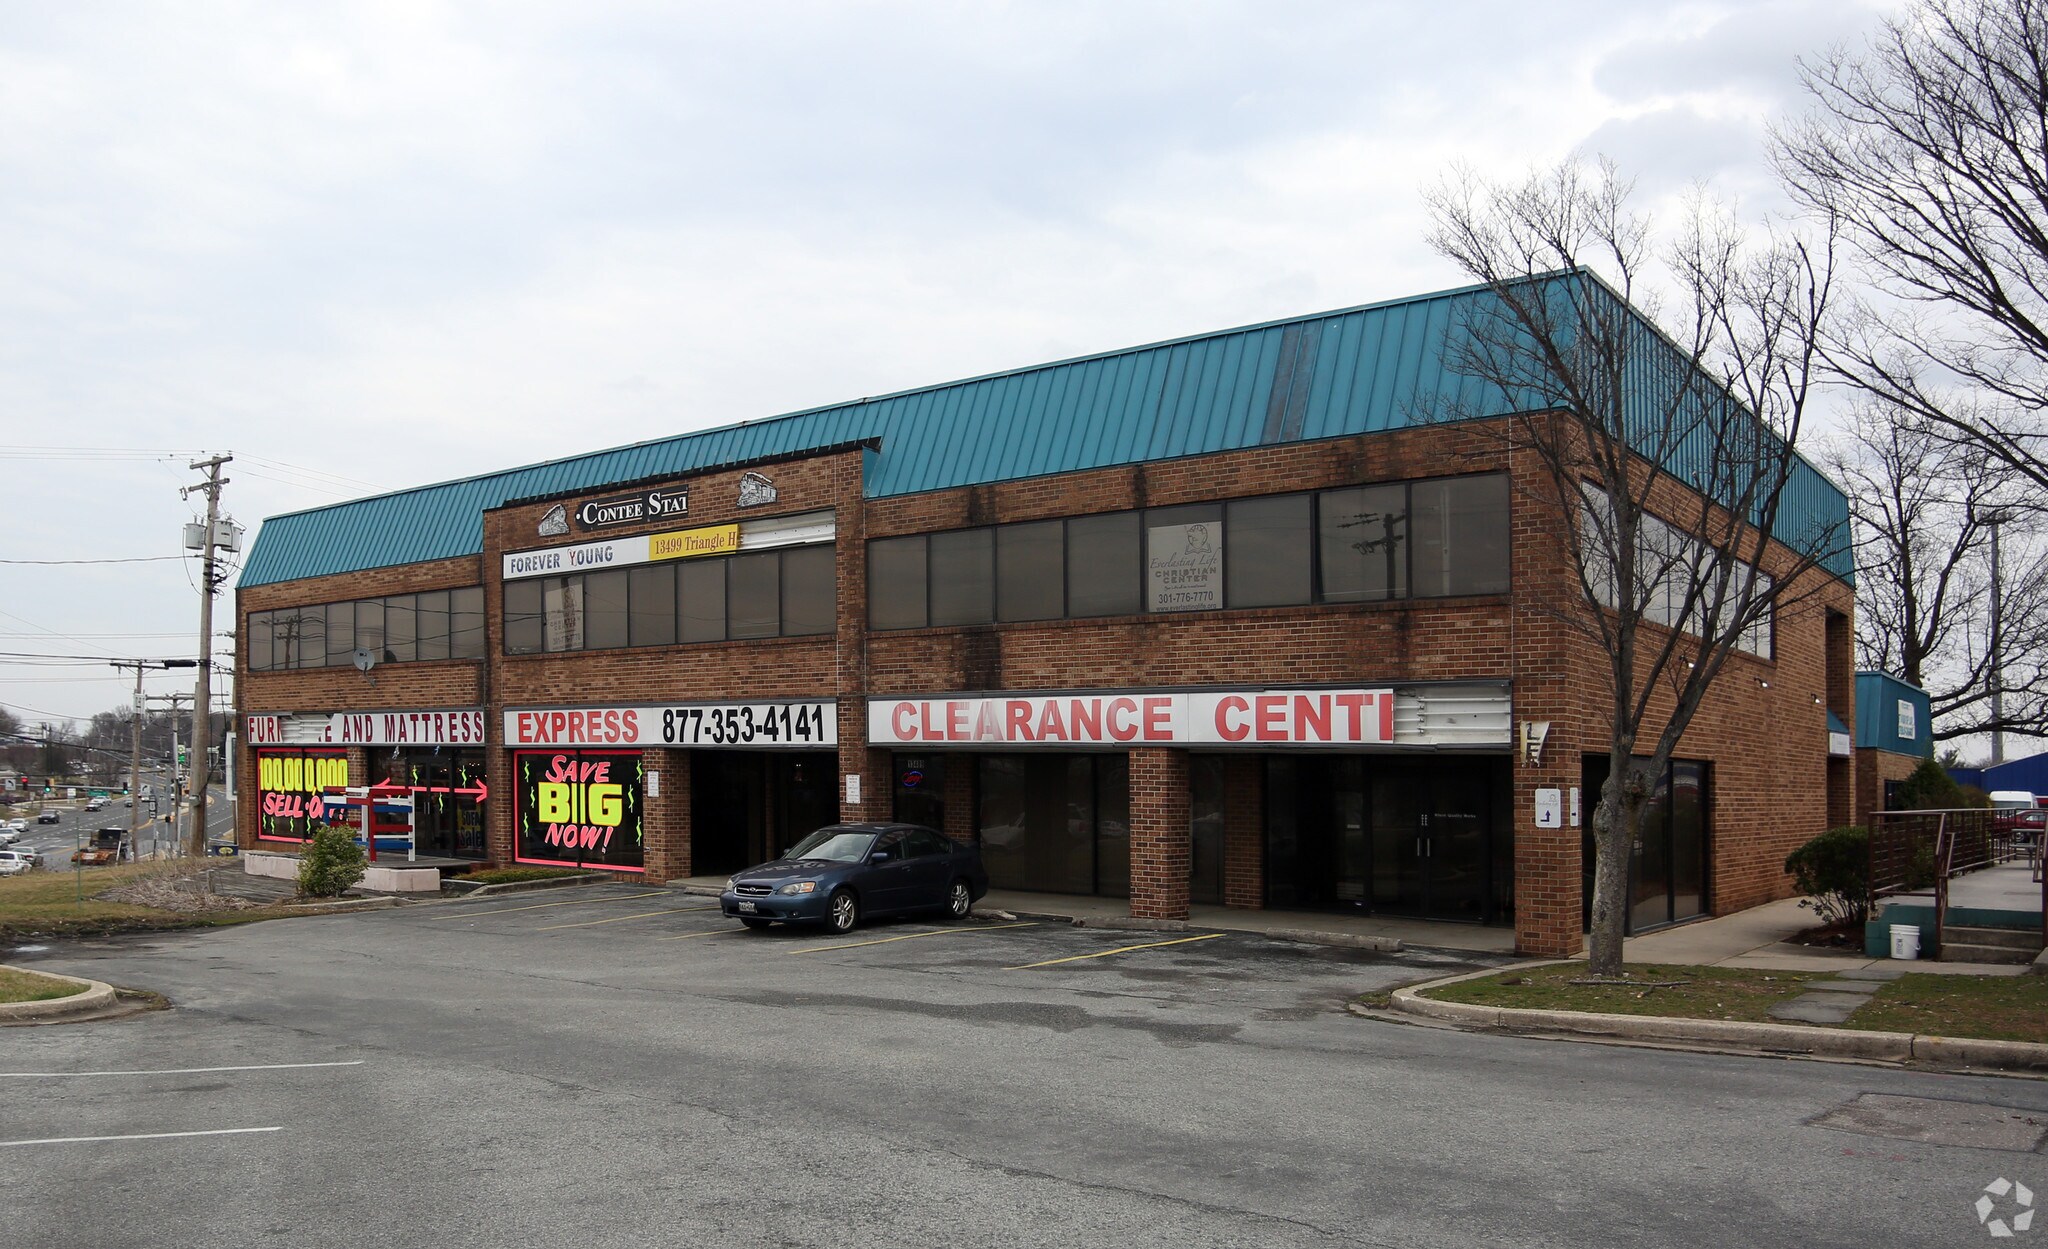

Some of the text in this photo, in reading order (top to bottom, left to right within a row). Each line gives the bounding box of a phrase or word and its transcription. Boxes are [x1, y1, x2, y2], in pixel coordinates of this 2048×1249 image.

[655, 538, 682, 555] 13499
[685, 533, 725, 552] Triangle
[510, 545, 613, 573] FOREVER YOUNG
[1150, 547, 1222, 570] Everlasting Life
[1155, 567, 1216, 577] CHRISTIAN
[1163, 575, 1208, 584] CENTER
[1158, 590, 1213, 604] 301-776-7770
[342, 714, 373, 743] AND
[384, 711, 483, 743] MATTRESS
[517, 704, 825, 743] EXPRESS 877-353-4141
[891, 697, 1173, 741] CLEARANCE
[545, 755, 611, 783] SAVE
[538, 782, 622, 827] BIG
[544, 822, 614, 854] NOW!
